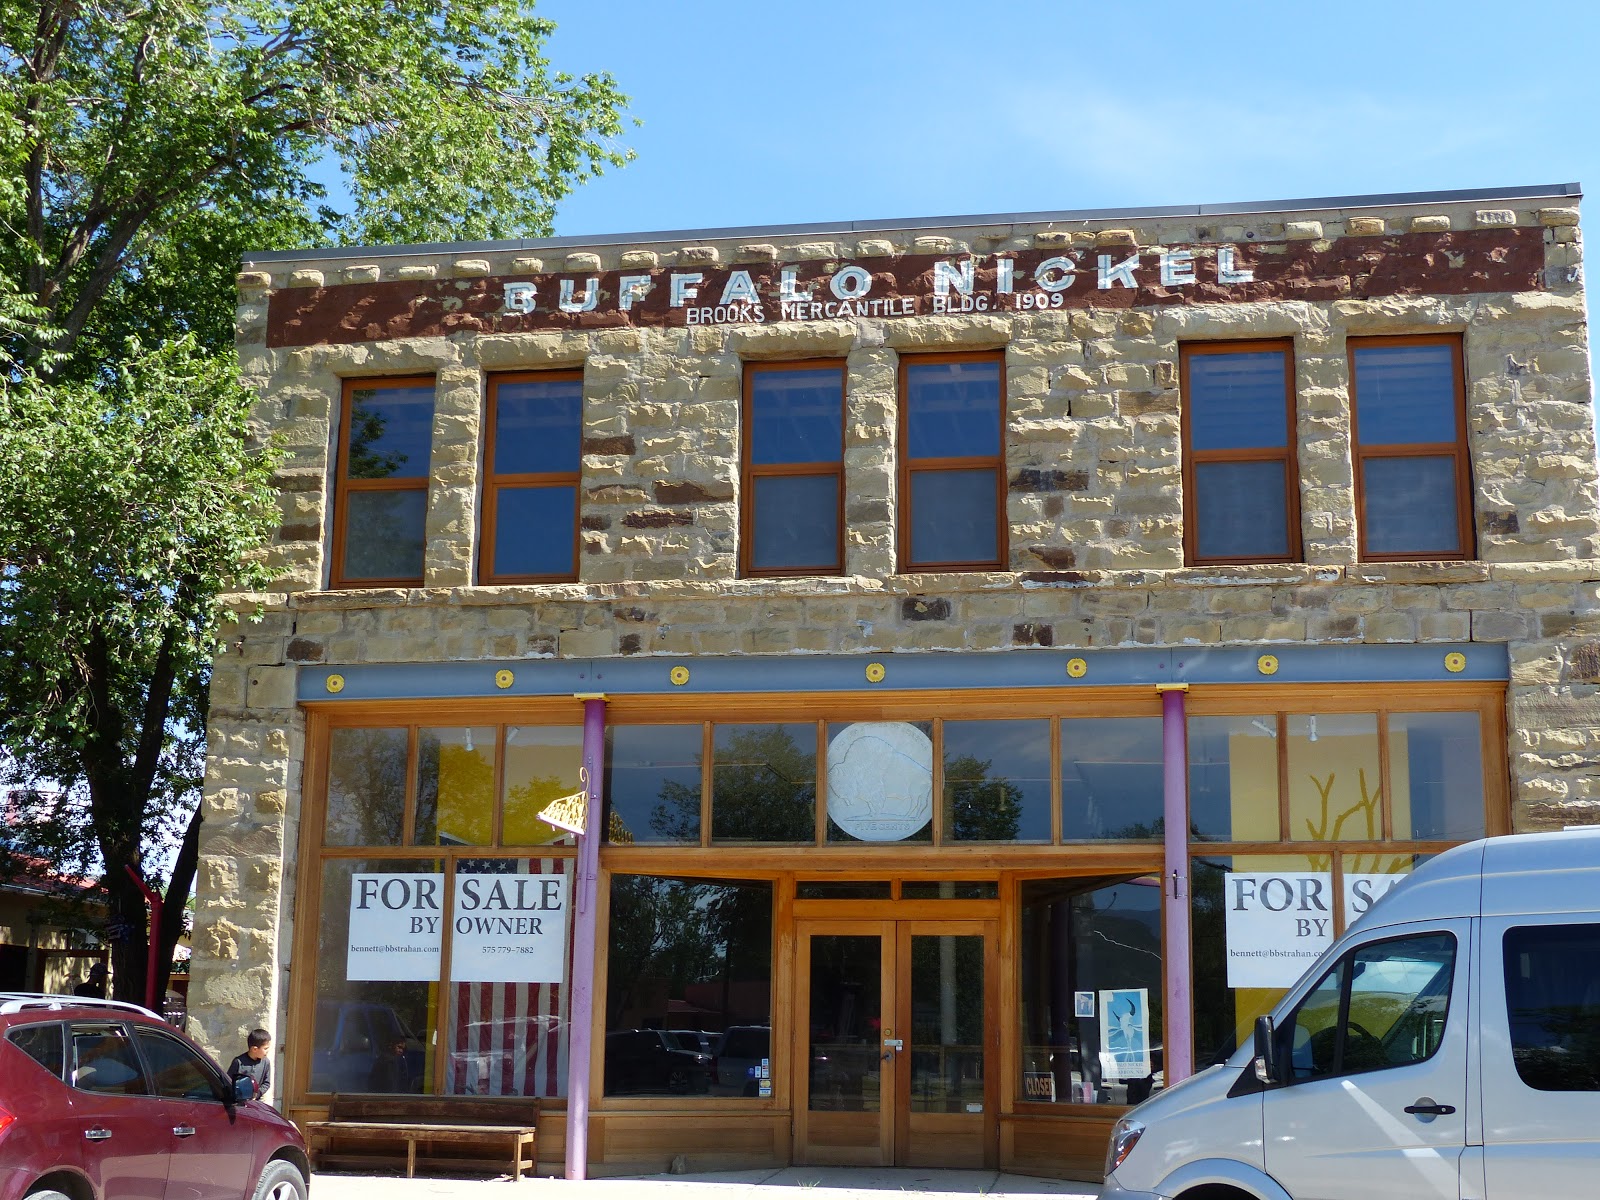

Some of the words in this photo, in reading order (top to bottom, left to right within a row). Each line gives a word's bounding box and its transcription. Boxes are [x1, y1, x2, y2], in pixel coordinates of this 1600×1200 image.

[503, 265, 872, 316] BUFFALO
[934, 248, 1254, 297] NICKEL
[686, 301, 765, 325] BROOKS
[781, 297, 915, 321] MERCANTILE
[933, 294, 997, 314] BLDG.
[1015, 292, 1064, 310] 1909
[356, 878, 440, 910] FOR
[461, 878, 562, 911] SALE
[1231, 877, 1328, 912] FOR
[409, 916, 440, 934] BY
[455, 916, 543, 935] OWNER
[1295, 918, 1330, 937] BY
[350, 944, 439, 953] bennett@bbstrahan.com
[482, 946, 496, 954] 575
[497, 946, 534, 954] 779-7882
[1230, 949, 1324, 958] bennett@bbstrahan.co
[1026, 1077, 1052, 1096] CLOSED
